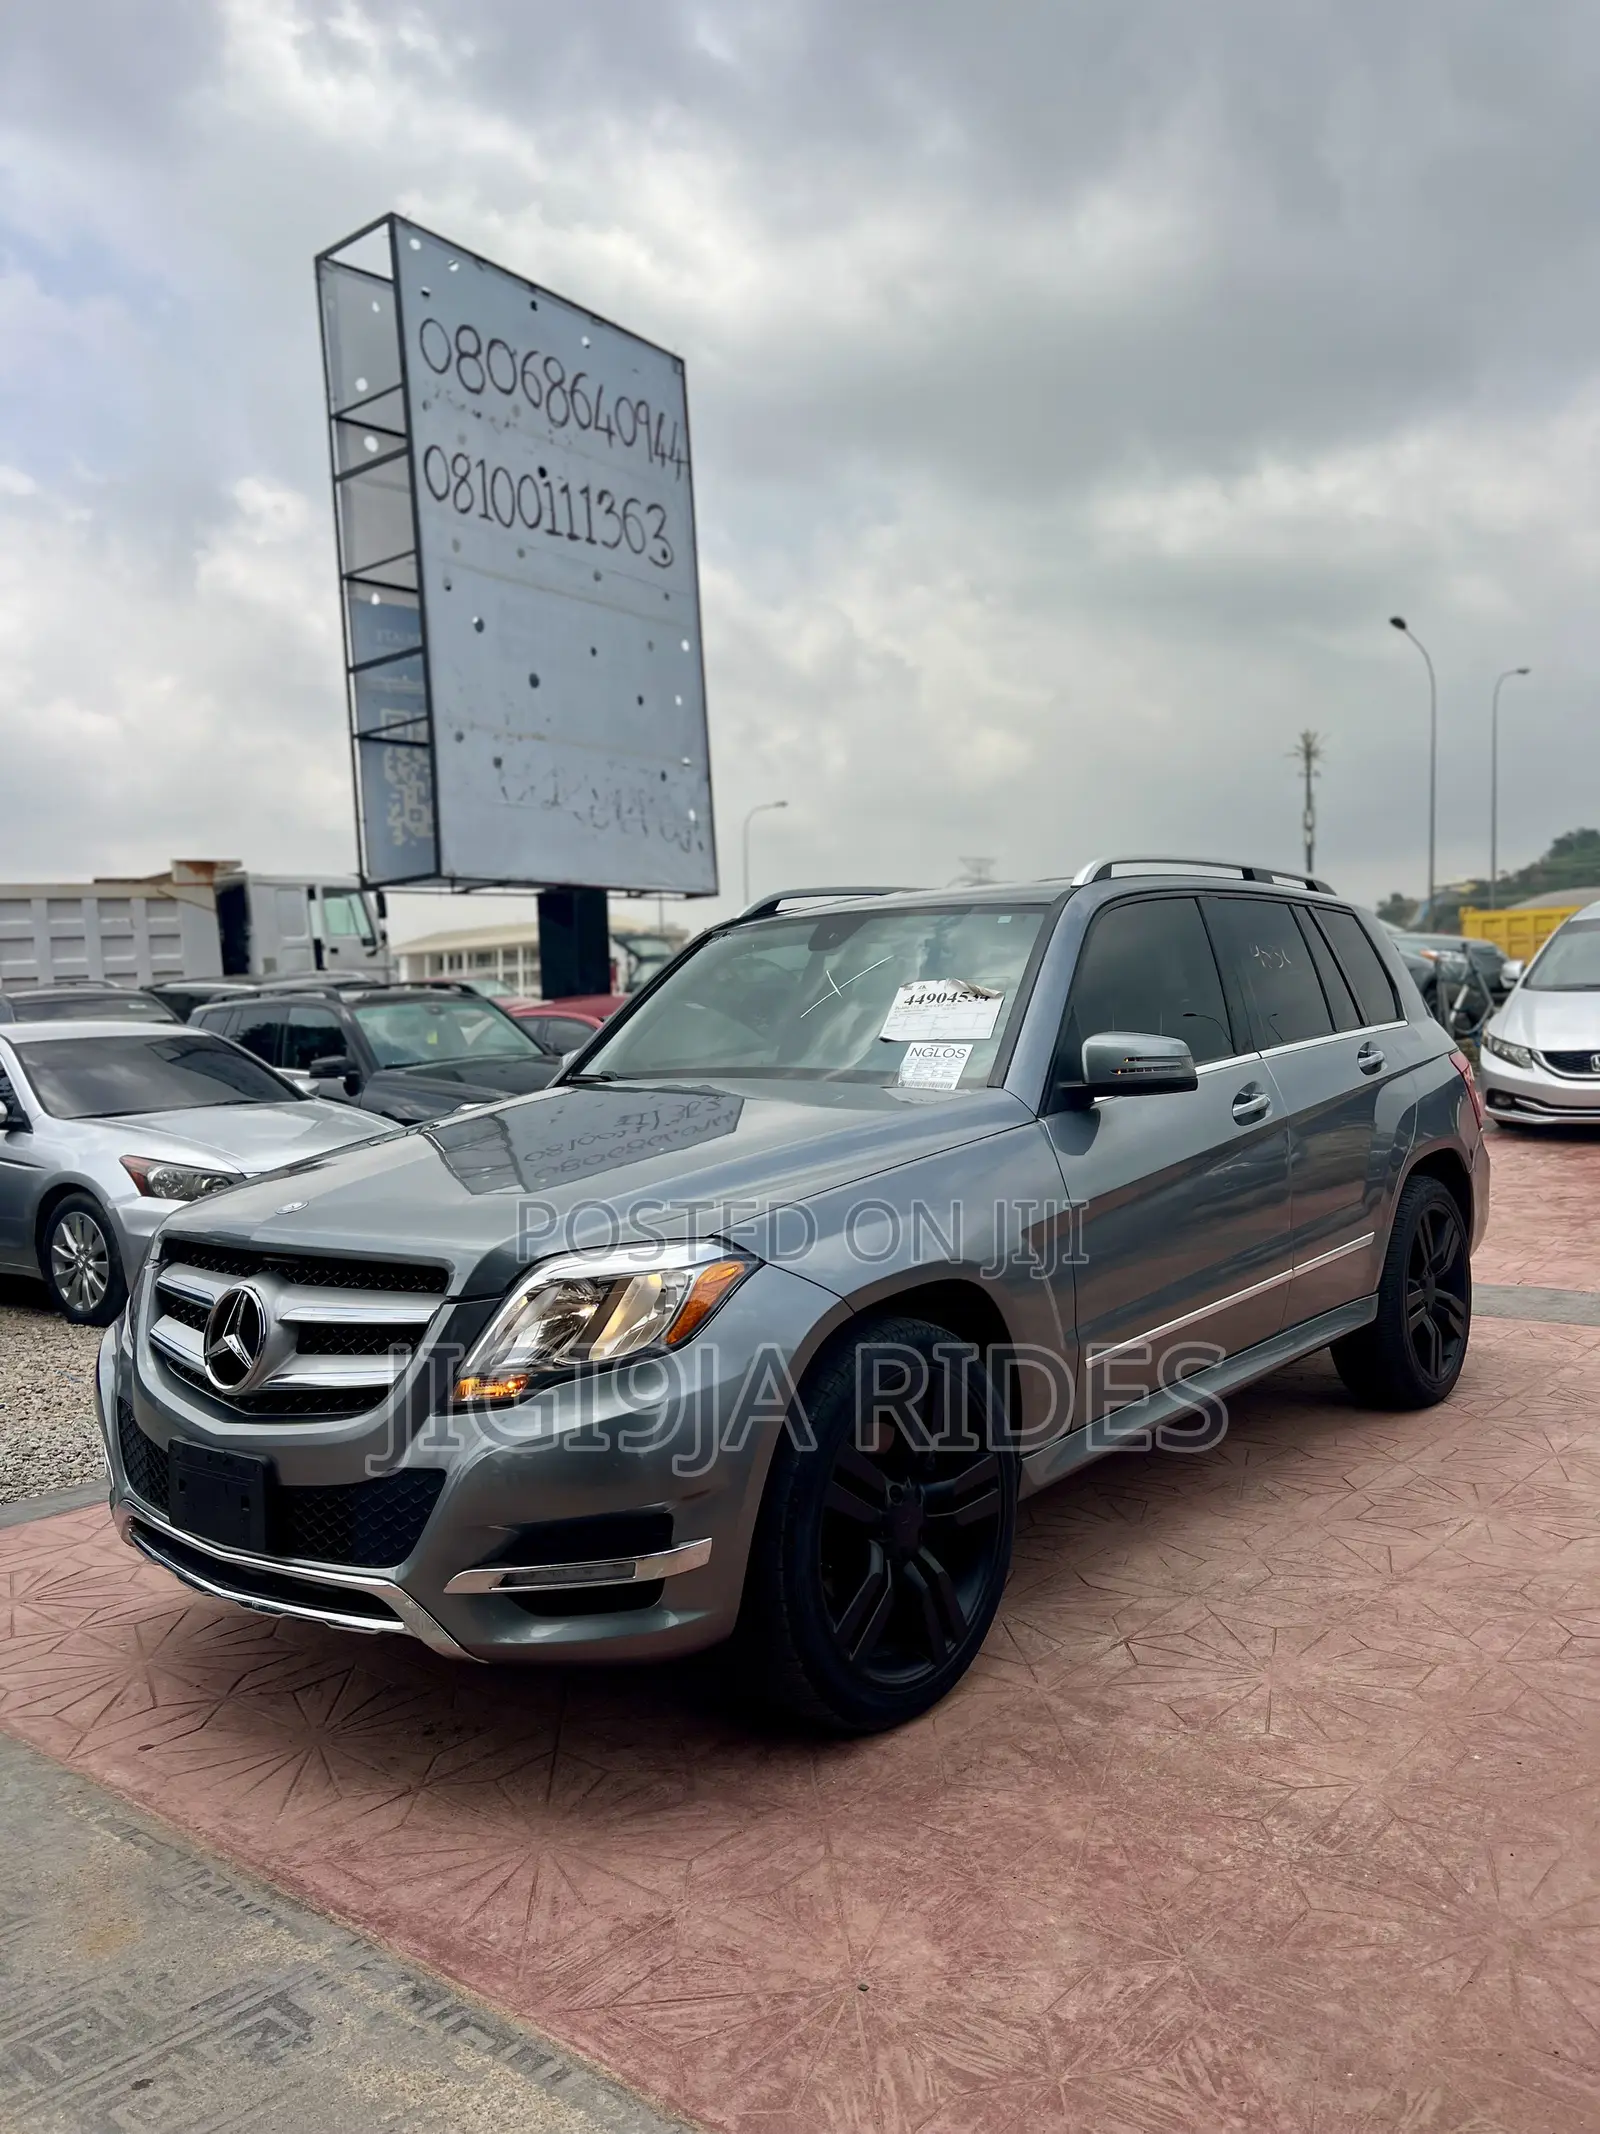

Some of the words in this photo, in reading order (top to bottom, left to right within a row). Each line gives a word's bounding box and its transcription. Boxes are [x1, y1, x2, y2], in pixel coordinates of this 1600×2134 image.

[419, 318, 690, 480] 08068640944
[424, 444, 674, 568] 08100111363
[910, 1047, 967, 1059] NGLOS
